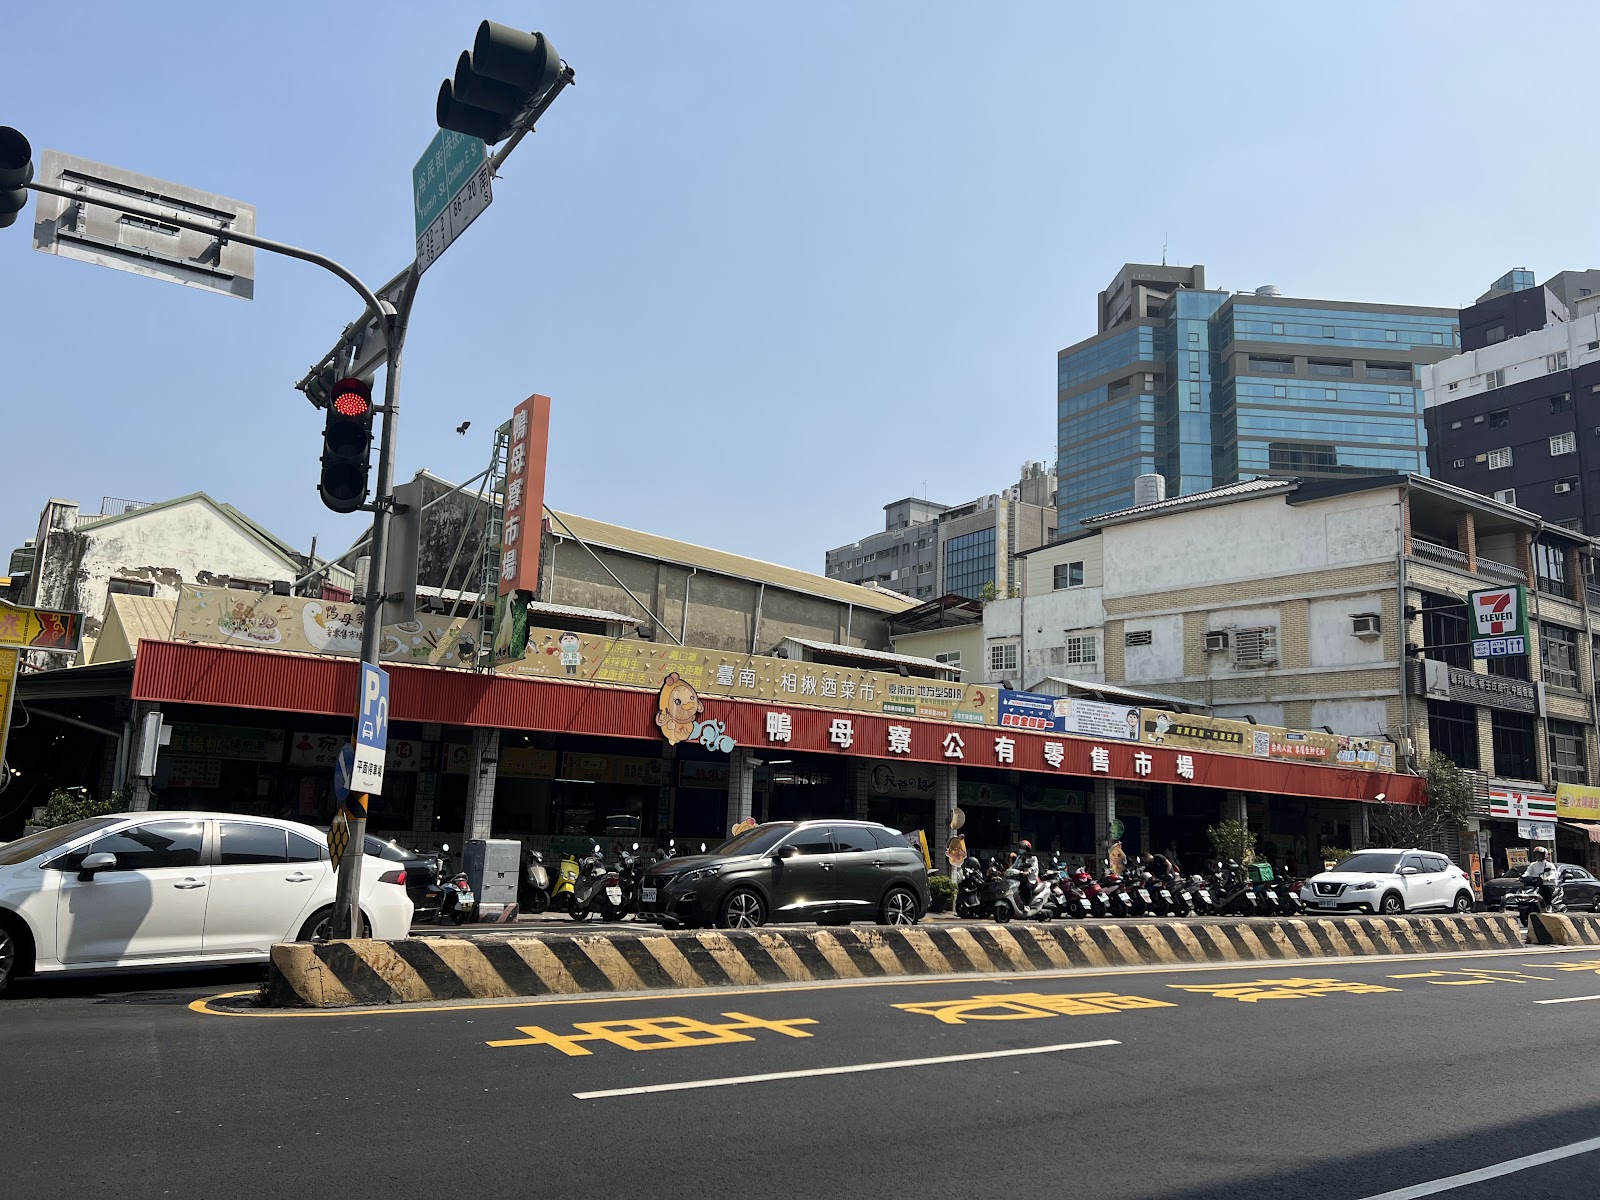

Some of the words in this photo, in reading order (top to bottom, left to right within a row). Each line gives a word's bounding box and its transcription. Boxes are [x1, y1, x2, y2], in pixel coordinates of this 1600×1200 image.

[418, 147, 444, 197] 裕民街
[478, 167, 489, 194] 南
[453, 180, 477, 218] 86-20
[501, 408, 529, 582] 鴨母寮市場
[1479, 592, 1511, 634] 7
[363, 669, 380, 716] P
[888, 683, 915, 696] 臺南市
[917, 685, 962, 700] 地方型SBIR
[765, 711, 1194, 780] 鴨母寮公有零售市場
[1512, 792, 1523, 816] 7
